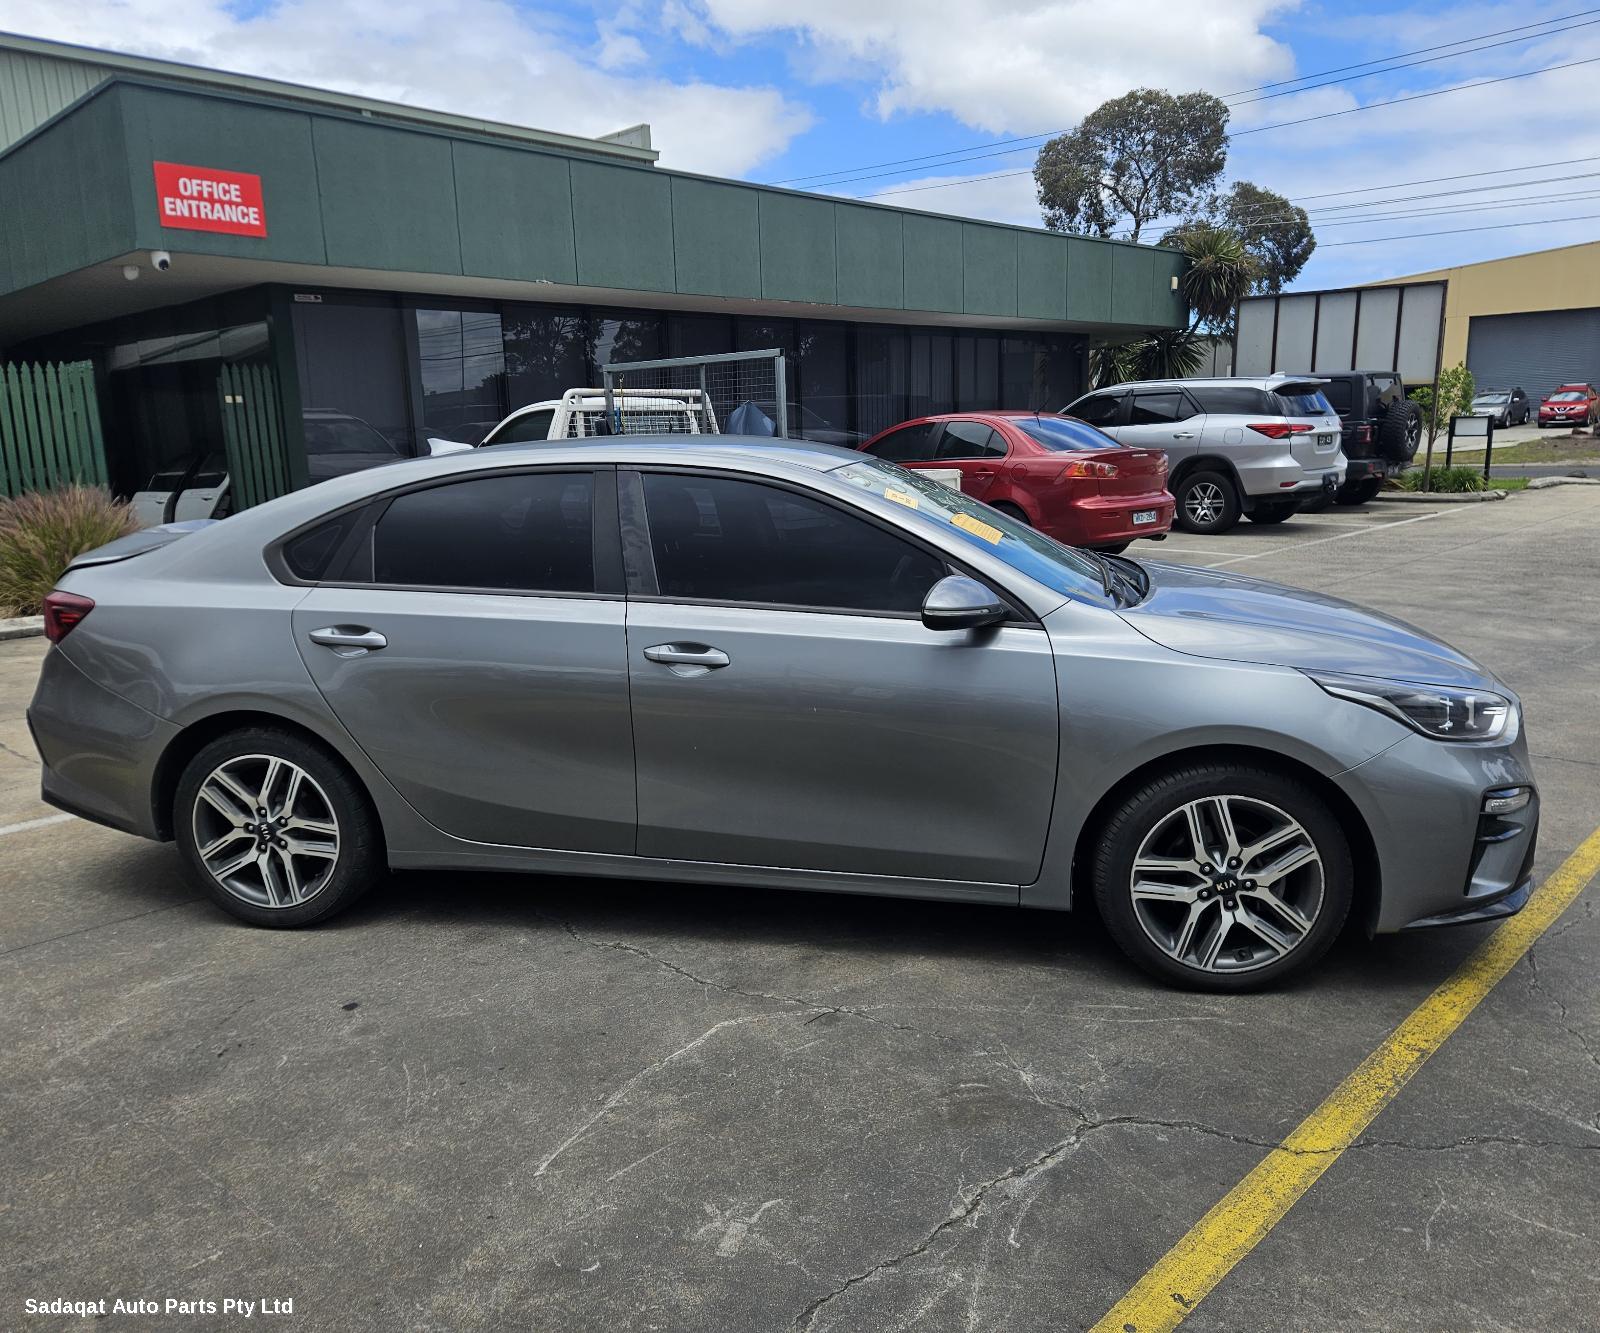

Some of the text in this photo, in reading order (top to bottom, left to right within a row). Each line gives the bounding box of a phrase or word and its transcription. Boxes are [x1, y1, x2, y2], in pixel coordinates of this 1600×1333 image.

[178, 177, 242, 203] OFFICE
[163, 197, 261, 226] ENTRANCE
[260, 824, 271, 840] KIA
[1216, 879, 1236, 891] KIA
